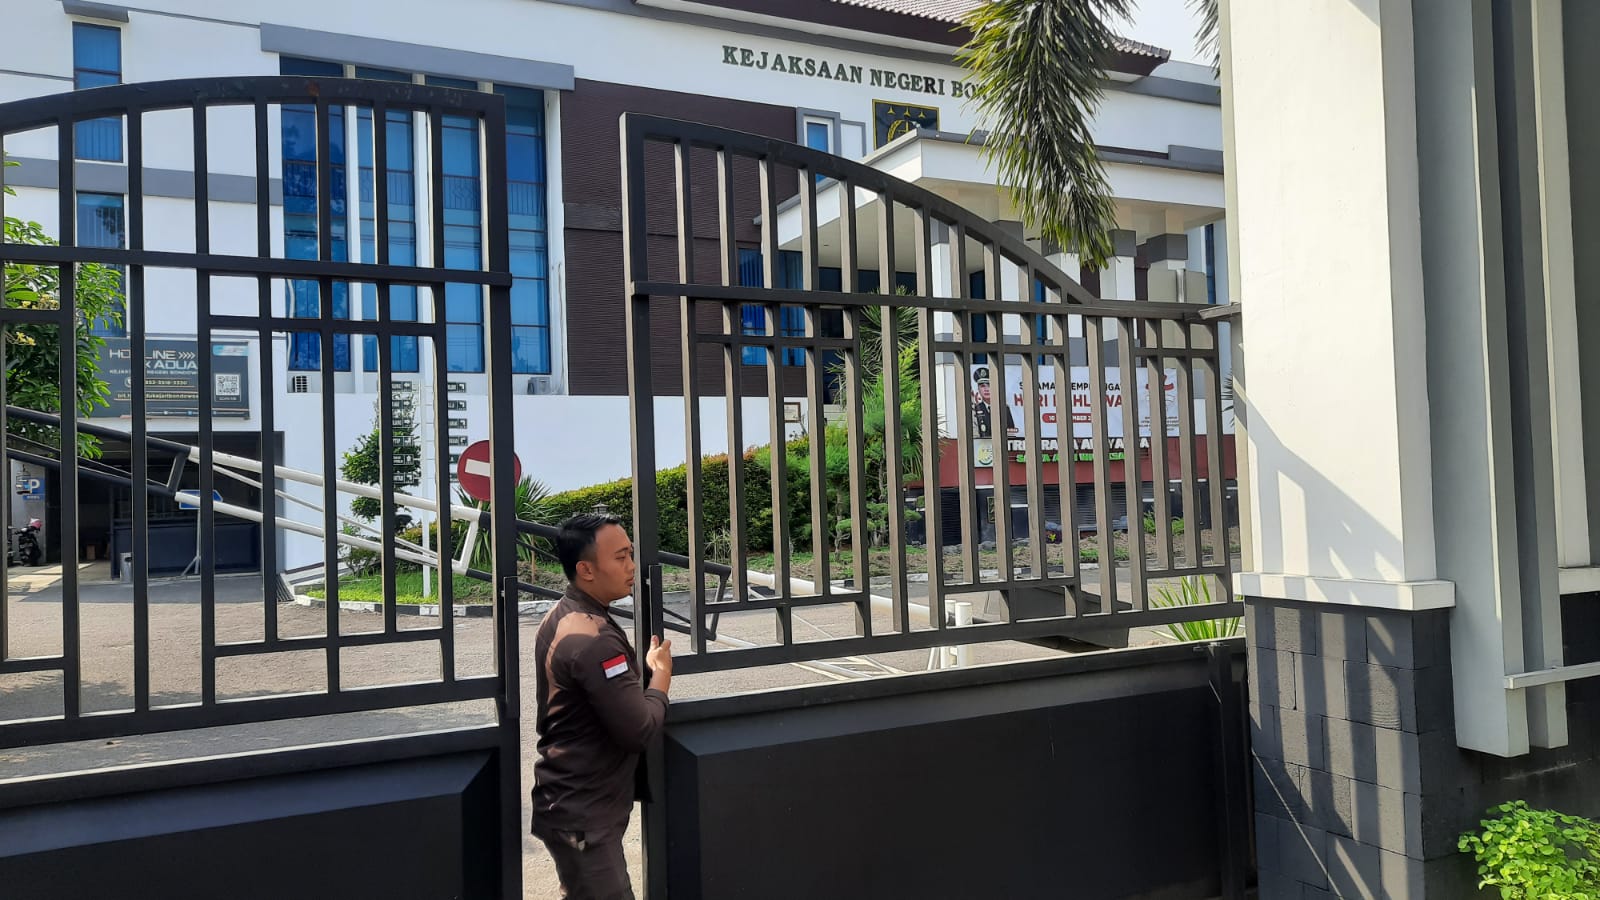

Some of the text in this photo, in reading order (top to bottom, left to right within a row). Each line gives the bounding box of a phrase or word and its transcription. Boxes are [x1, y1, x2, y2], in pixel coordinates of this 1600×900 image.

[722, 45, 863, 84] KEJAKSAAN
[870, 69, 945, 96] NEGERI
[154, 360, 198, 370] ADUA
[1014, 393, 1048, 407] HRI
